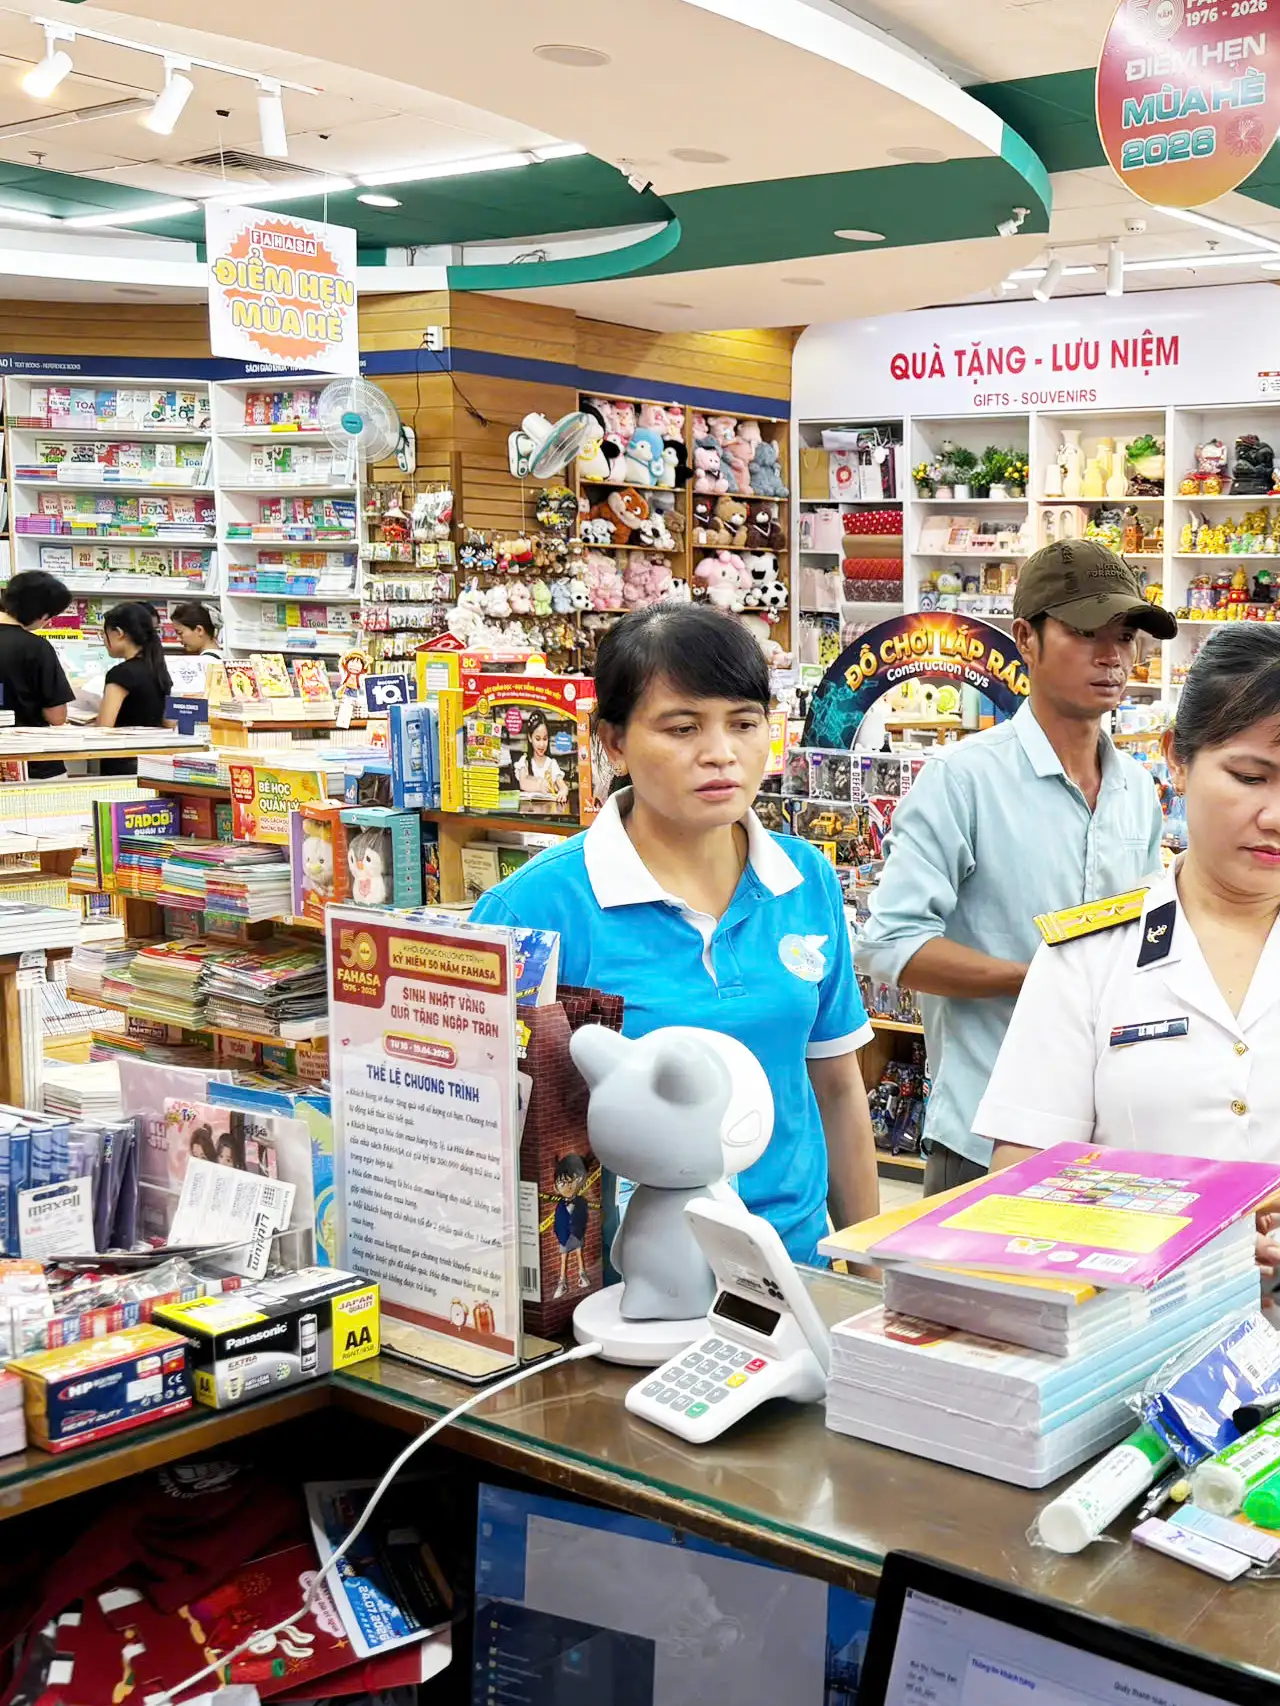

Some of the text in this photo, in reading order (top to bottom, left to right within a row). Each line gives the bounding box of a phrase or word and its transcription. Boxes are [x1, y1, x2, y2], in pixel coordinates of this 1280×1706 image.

[1186, 8, 1218, 27] 1976
[1231, 1, 1268, 18] 2026
[1202, 33, 1267, 68] HẸN
[1122, 66, 1267, 129] MÙA HÈ
[1121, 126, 1215, 171] 2026
[252, 231, 316, 254] FAHASA
[212, 248, 354, 309] ĐIỂM HẸN
[232, 297, 343, 342] MÙA HÈ
[890, 343, 946, 382] QUÀ
[954, 341, 1026, 385] TẶNG
[1052, 336, 1101, 372] LƯU
[1110, 329, 1179, 375] NIỆM
[973, 393, 1010, 407] GIFTS
[1021, 388, 1097, 405] SOUVENIRS
[844, 625, 1030, 697] ĐỒ CHƠI LẮP RÁP
[887, 660, 989, 688] Construction toys
[258, 780, 290, 796] BÉ HỌC
[259, 796, 286, 813] QUẢN
[337, 968, 381, 987] FAHASA
[406, 956, 427, 970] NIỆM
[428, 960, 438, 969] 50
[461, 966, 496, 980] FAHASA
[403, 986, 486, 1015] SINH NHẬT VÀNG
[391, 1002, 499, 1039] QUÀ TẶNG NGẬP TRÀN
[366, 1060, 479, 1103] THỂ LỆ CHƯƠNG TRÌNH
[28, 1194, 80, 1218] maxell
[251, 1213, 270, 1271] Lithium
[338, 1294, 373, 1310] JAPAN
[348, 1300, 373, 1313] QUALITY
[226, 1322, 287, 1350] Panasonic
[345, 1326, 372, 1350] AA
